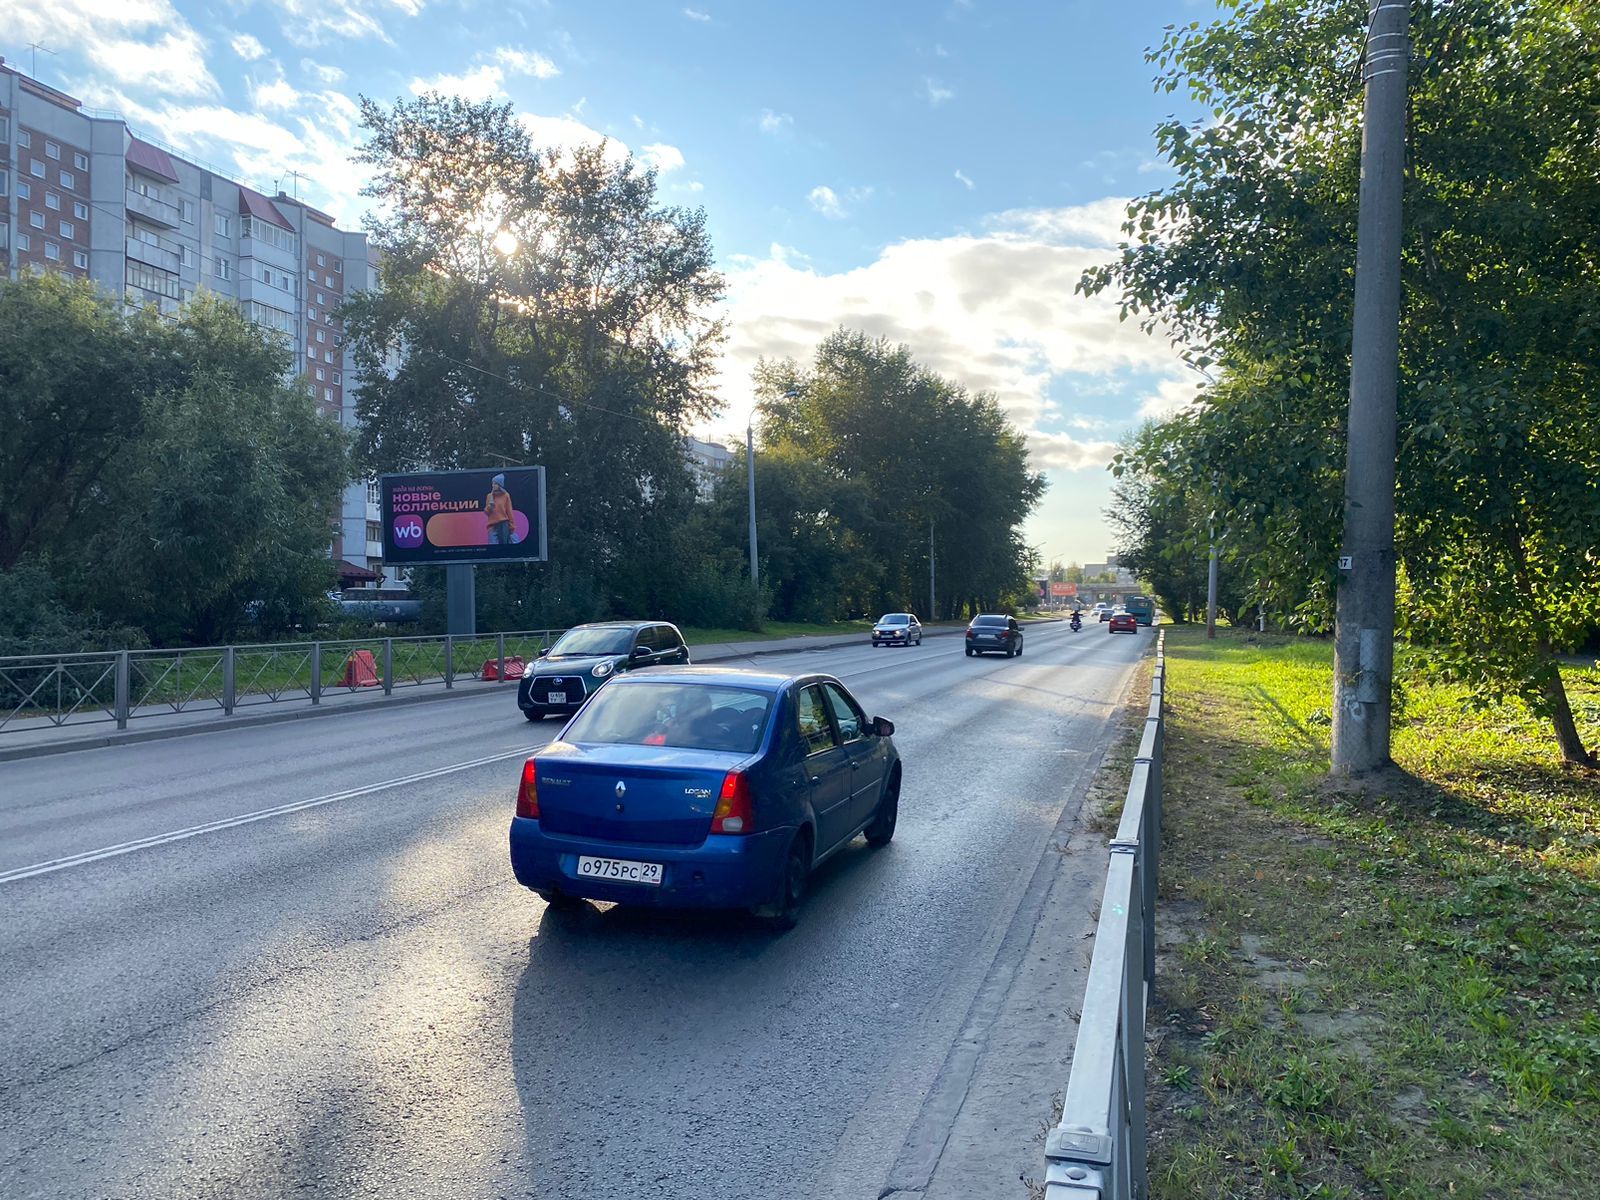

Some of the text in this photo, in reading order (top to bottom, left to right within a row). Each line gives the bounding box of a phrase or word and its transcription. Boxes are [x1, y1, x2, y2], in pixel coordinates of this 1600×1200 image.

[393, 492, 441, 502] новые
[393, 500, 479, 512] коллекции
[395, 521, 422, 538] wb
